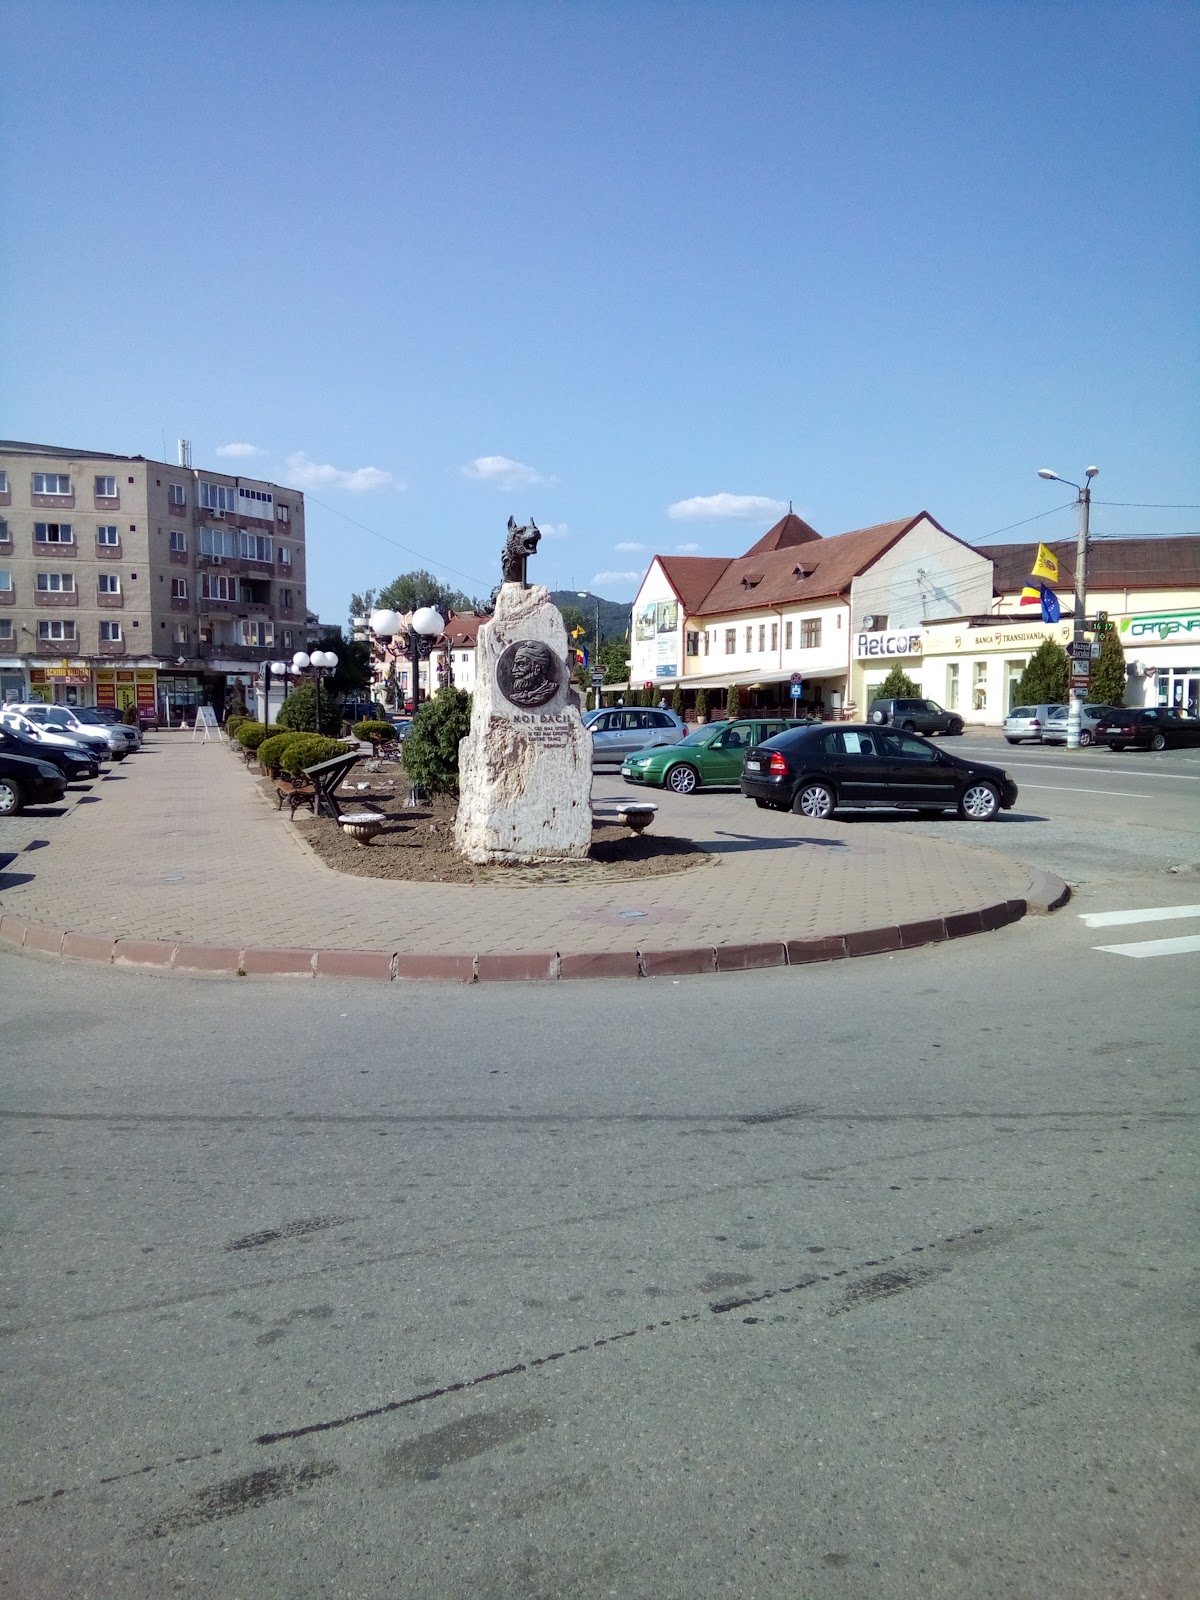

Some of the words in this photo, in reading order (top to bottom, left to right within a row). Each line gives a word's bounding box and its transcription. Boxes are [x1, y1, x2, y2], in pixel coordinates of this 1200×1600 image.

[975, 636, 993, 644] BANCA
[1003, 632, 1044, 642] TRANSILVANIA
[46, 668, 66, 677] SCHIMB
[514, 714, 535, 724] NOI
[540, 714, 570, 723] DACII
